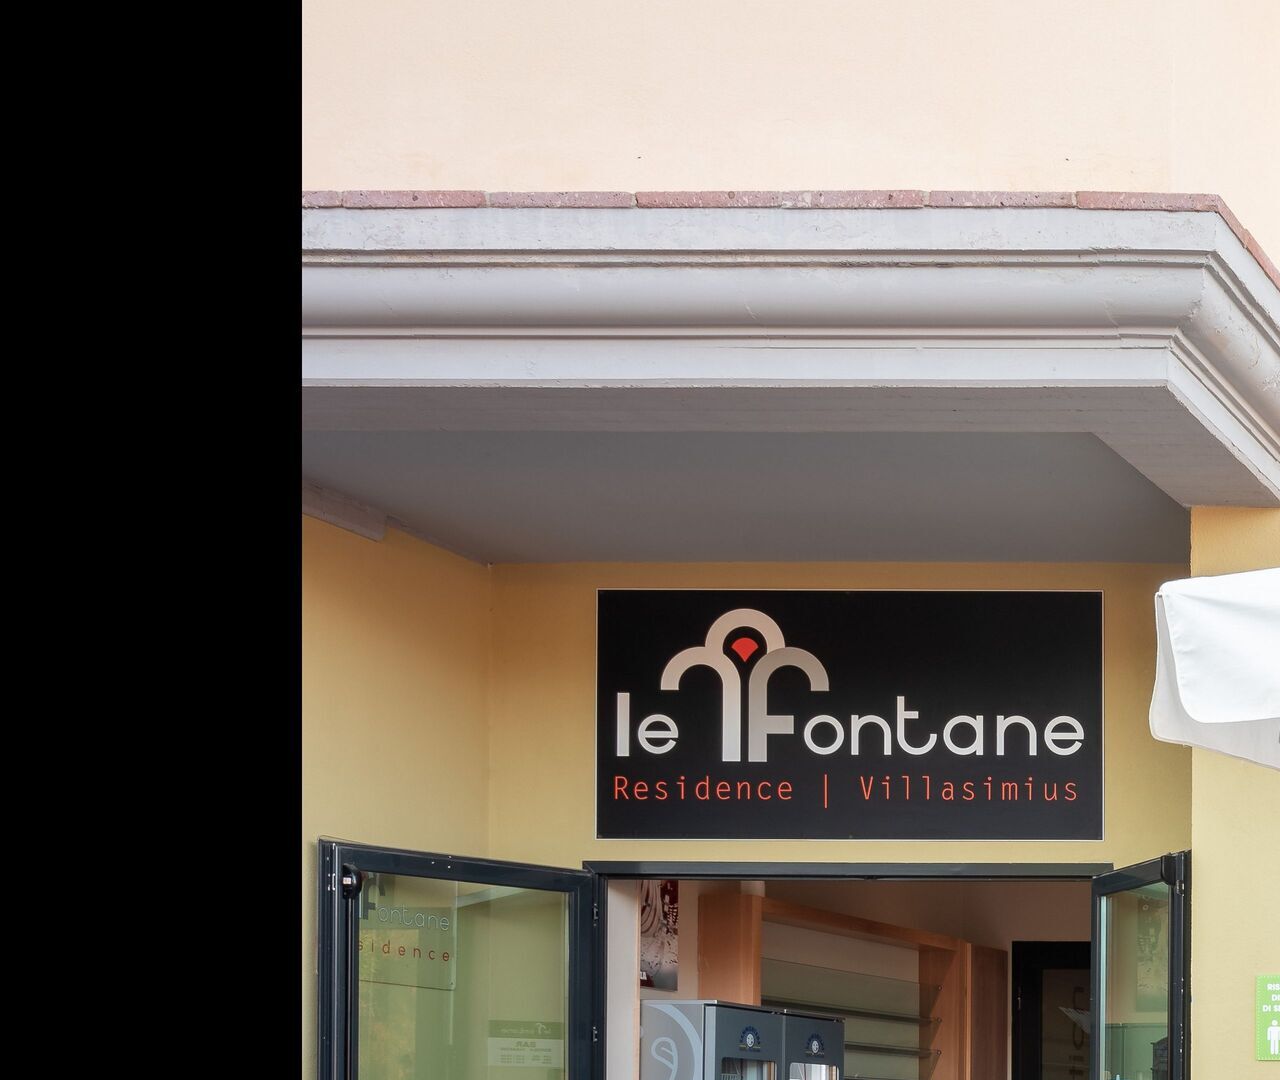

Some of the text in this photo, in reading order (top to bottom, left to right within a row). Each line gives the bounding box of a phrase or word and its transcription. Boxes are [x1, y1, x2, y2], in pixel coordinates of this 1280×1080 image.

[616, 691, 680, 758] le
[613, 774, 1079, 802] Residence Villasimius
[358, 939, 450, 962] sidence
[1262, 1004, 1271, 1013] DI
